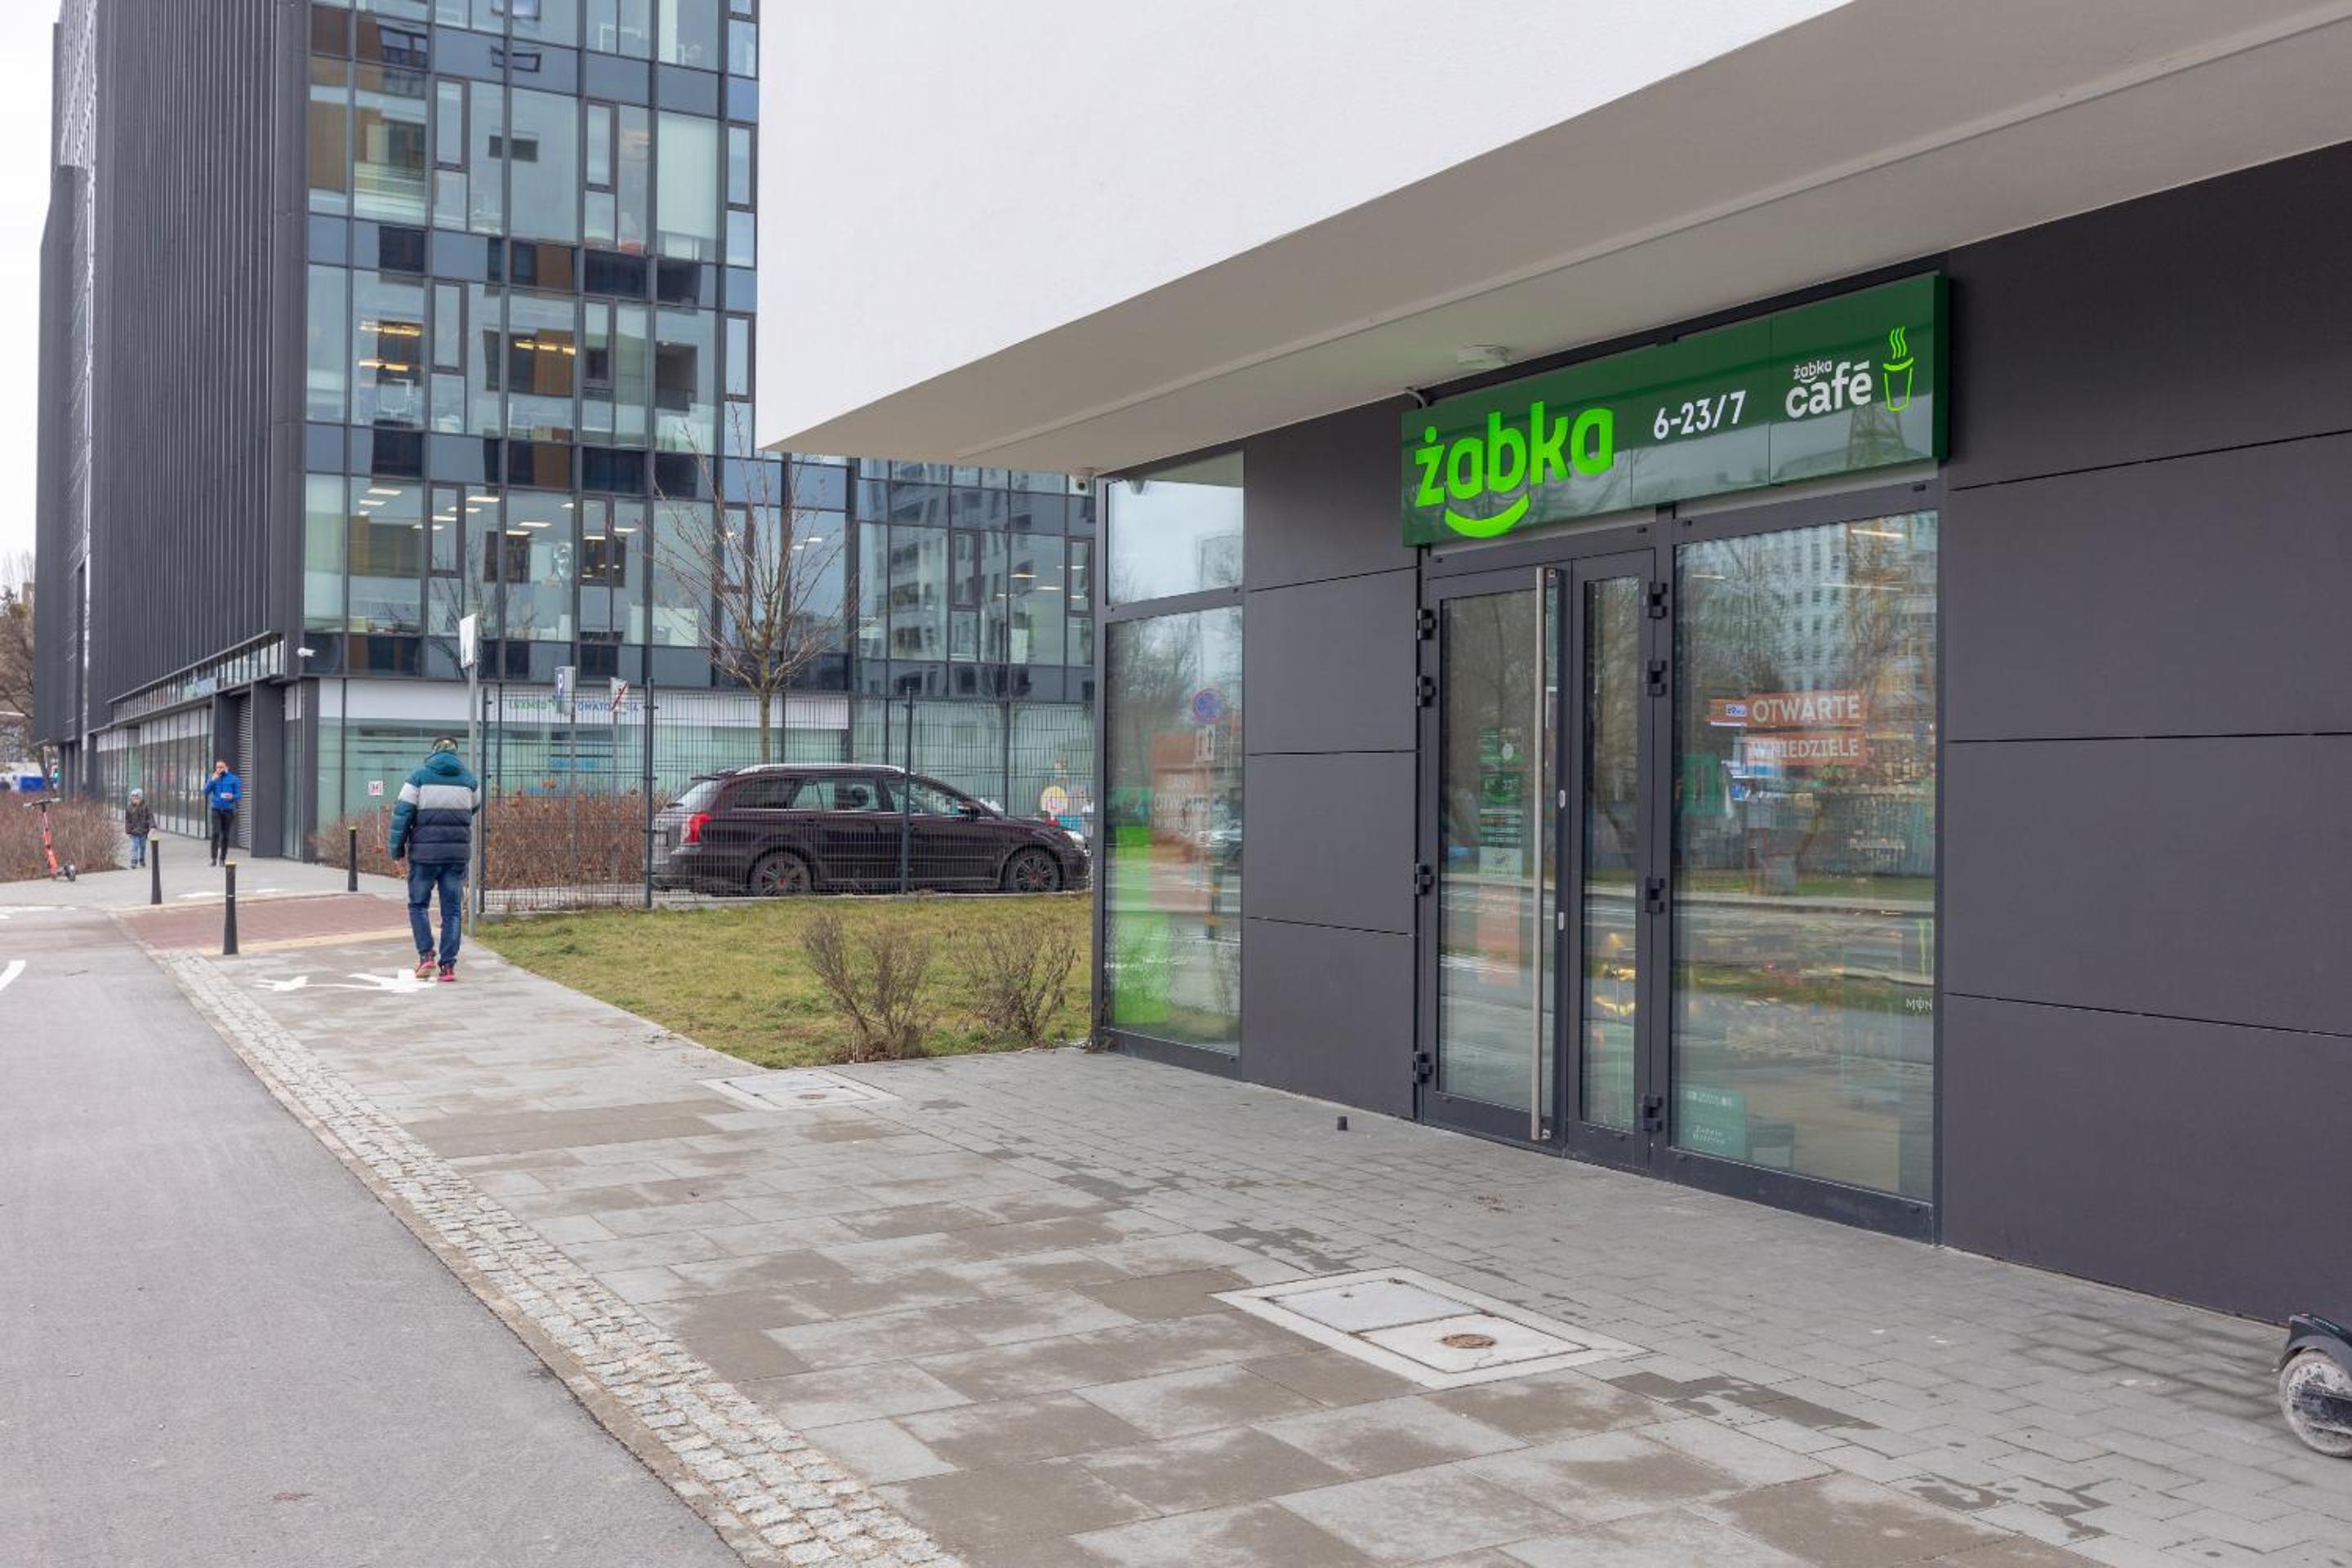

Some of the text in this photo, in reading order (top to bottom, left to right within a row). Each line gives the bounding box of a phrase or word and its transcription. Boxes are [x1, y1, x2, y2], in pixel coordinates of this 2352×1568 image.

[1793, 360, 1833, 380] żabka
[1653, 390, 1746, 440] 6-23/7
[1415, 400, 1615, 508] żabka
[1753, 694, 1860, 723] OTWARTE
